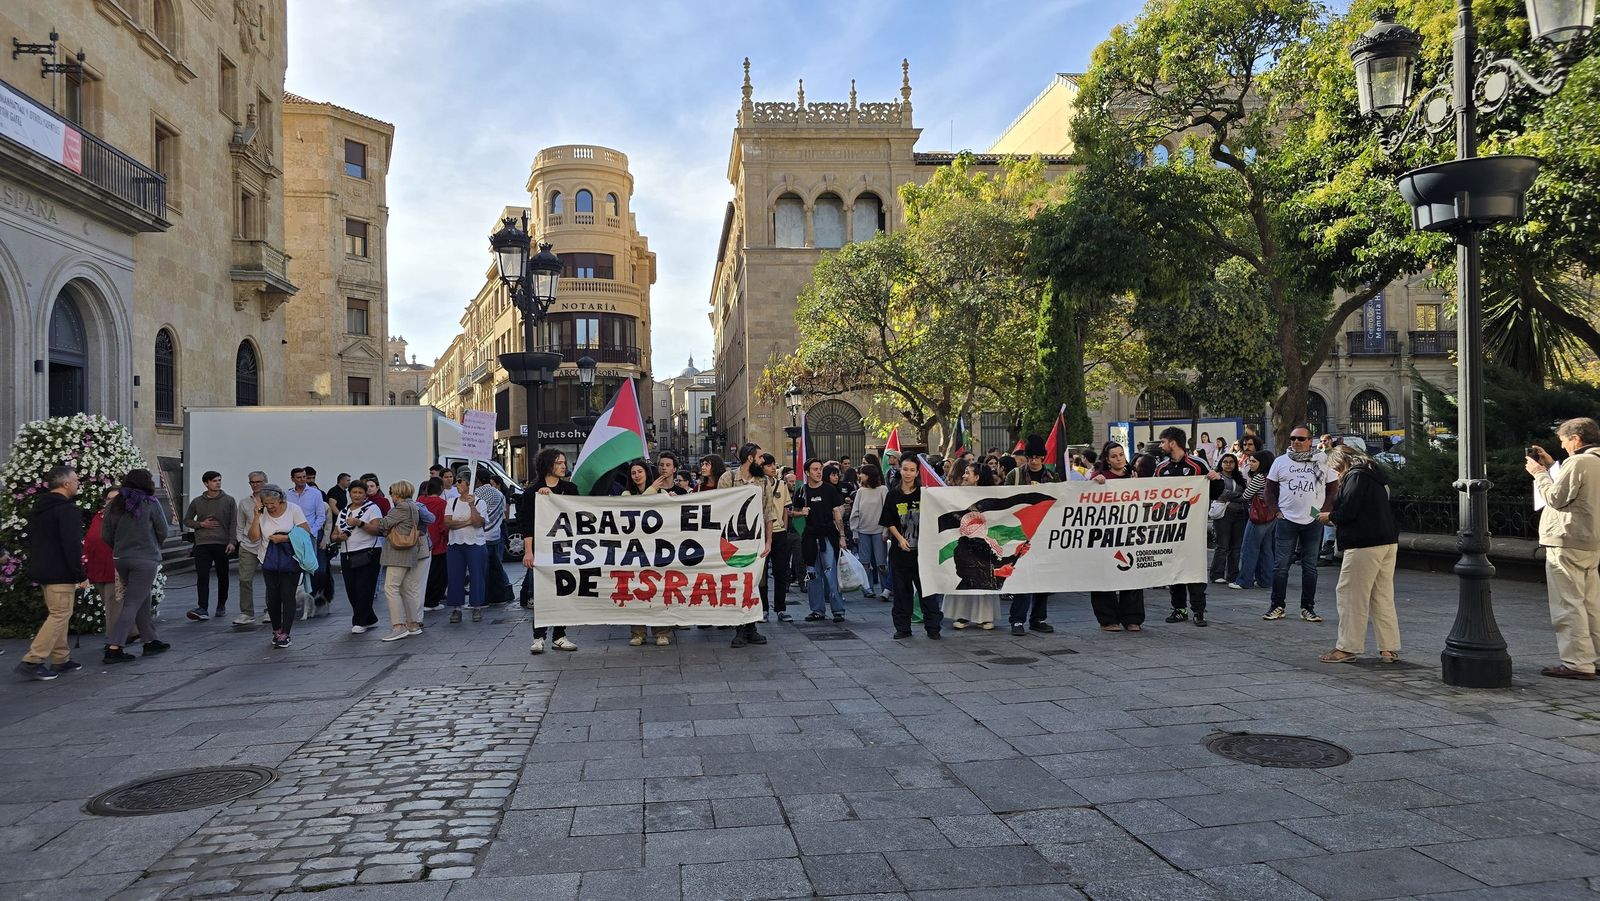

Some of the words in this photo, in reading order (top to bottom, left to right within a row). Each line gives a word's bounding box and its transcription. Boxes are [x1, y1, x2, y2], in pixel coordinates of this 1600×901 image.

[2, 185, 58, 225] SPAÑA
[561, 302, 617, 311] NOTARÍA
[1079, 490, 1140, 504] HUELGA
[1144, 488, 1159, 500] 15
[1161, 487, 1193, 499] OCT
[1288, 478, 1315, 492] GAZA
[547, 509, 663, 537] ABAJO
[680, 505, 721, 532] EL
[1061, 503, 1138, 527] PARARLO
[1142, 501, 1192, 523] TODO
[1048, 529, 1084, 549] POR
[1087, 522, 1187, 548] PALESTINA
[552, 538, 705, 567] ESTADO
[1135, 548, 1173, 557] COORDINADORA
[1136, 561, 1163, 569] SOCIALISTA
[555, 567, 601, 597] DE
[609, 569, 760, 608] ISRAEL
